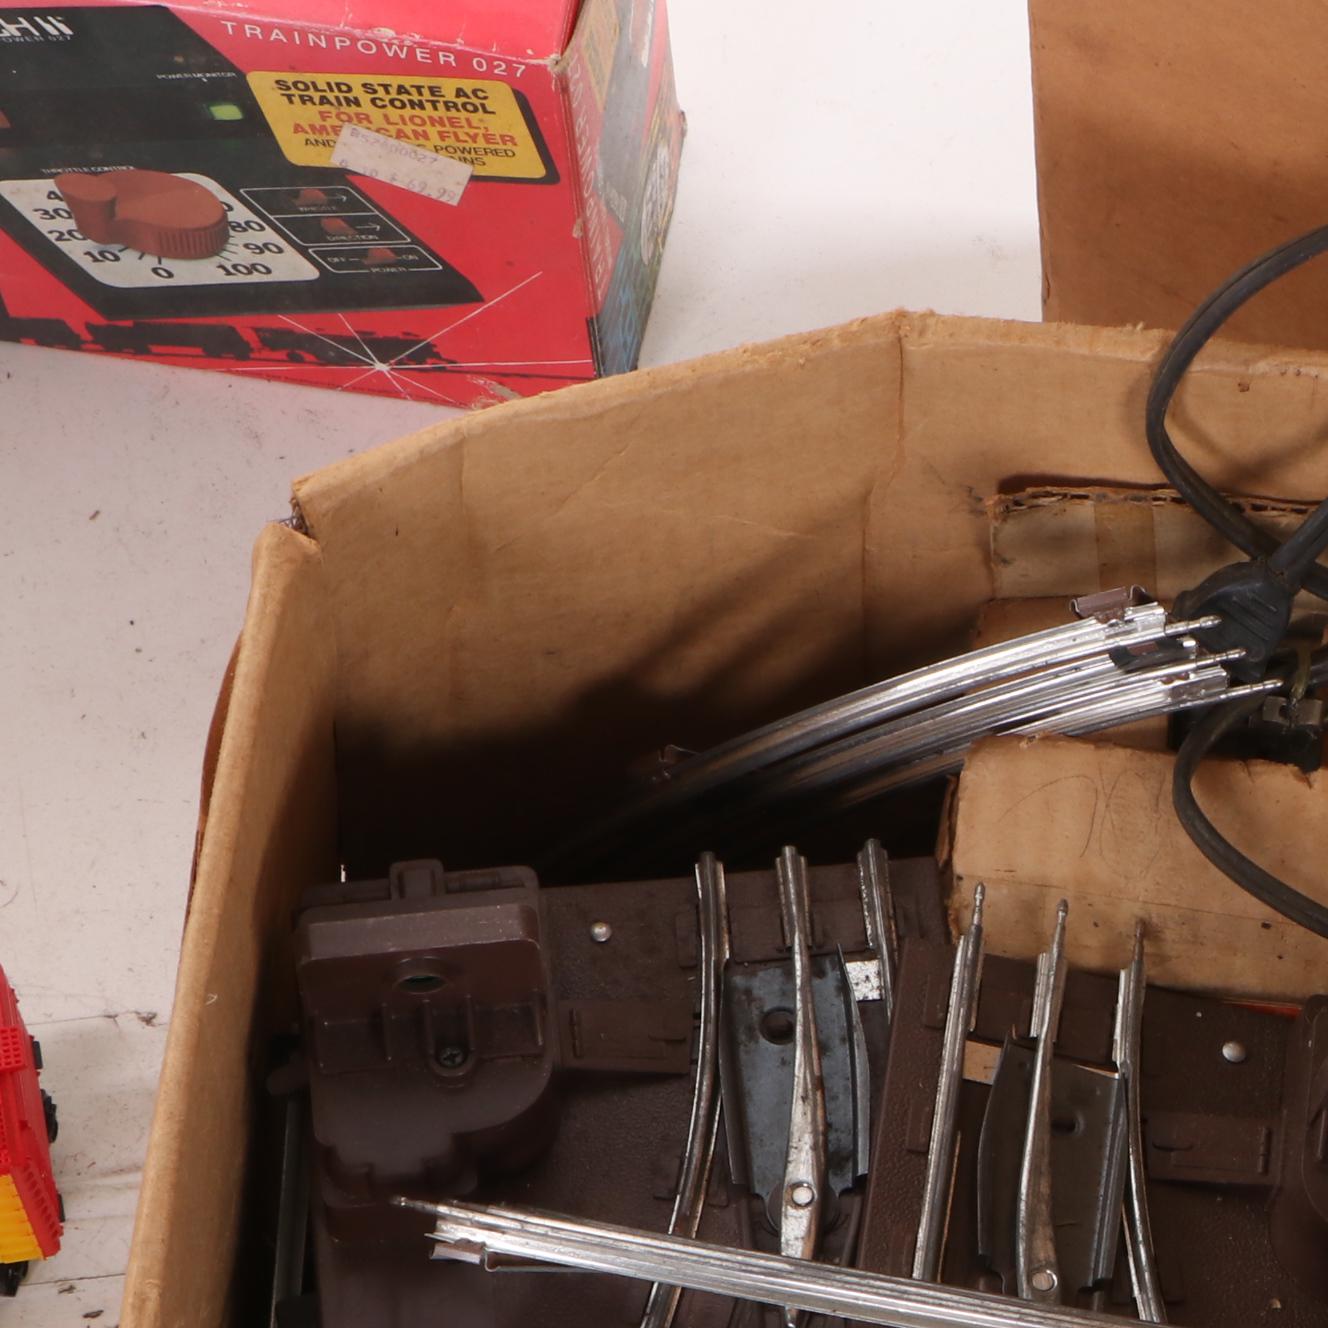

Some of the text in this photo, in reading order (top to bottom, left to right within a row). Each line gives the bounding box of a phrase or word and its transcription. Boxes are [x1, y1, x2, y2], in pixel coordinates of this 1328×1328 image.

[221, 20, 527, 78] TRAINPOWER 027
[274, 79, 490, 101] SOLID STATE AC
[280, 93, 497, 115] TRAIN CONTROL
[318, 110, 491, 132] FOR LIONEL,
[437, 130, 519, 146] FLYER
[433, 144, 516, 159] POWERED
[33, 207, 74, 221] 30
[228, 220, 266, 233] 80
[47, 229, 88, 242] 20
[242, 242, 286, 255] 90
[83, 250, 121, 263] 10
[150, 266, 175, 280] 0
[215, 262, 273, 276] 100
